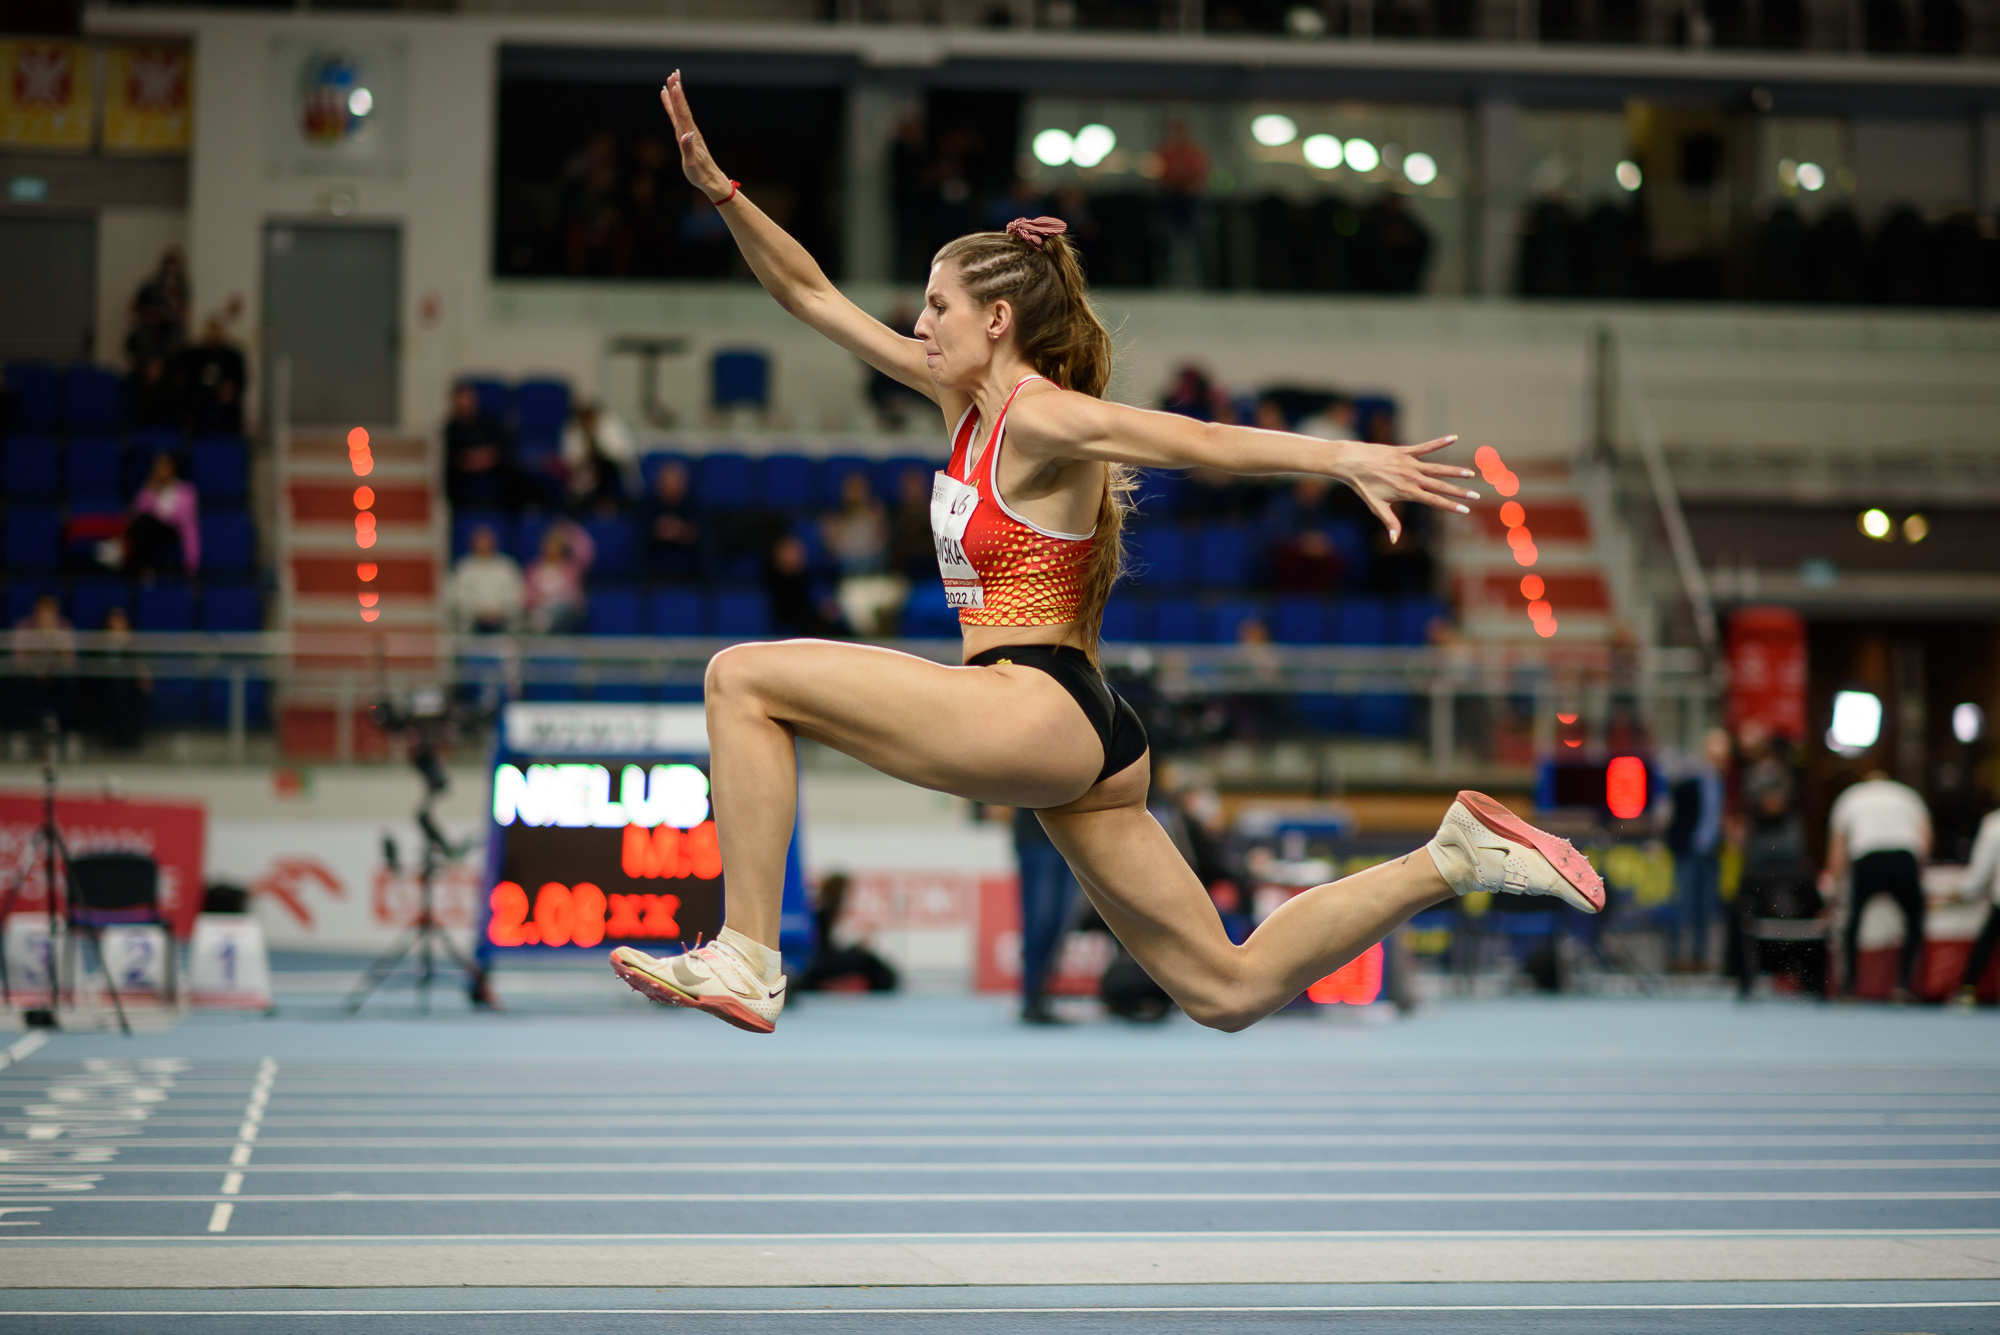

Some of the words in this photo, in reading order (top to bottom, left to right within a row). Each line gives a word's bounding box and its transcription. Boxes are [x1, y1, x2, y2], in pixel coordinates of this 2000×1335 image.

[945, 591, 968, 605] 2022
[488, 881, 607, 948] 2.08
[121, 931, 154, 988] 2
[218, 935, 239, 990] 1
